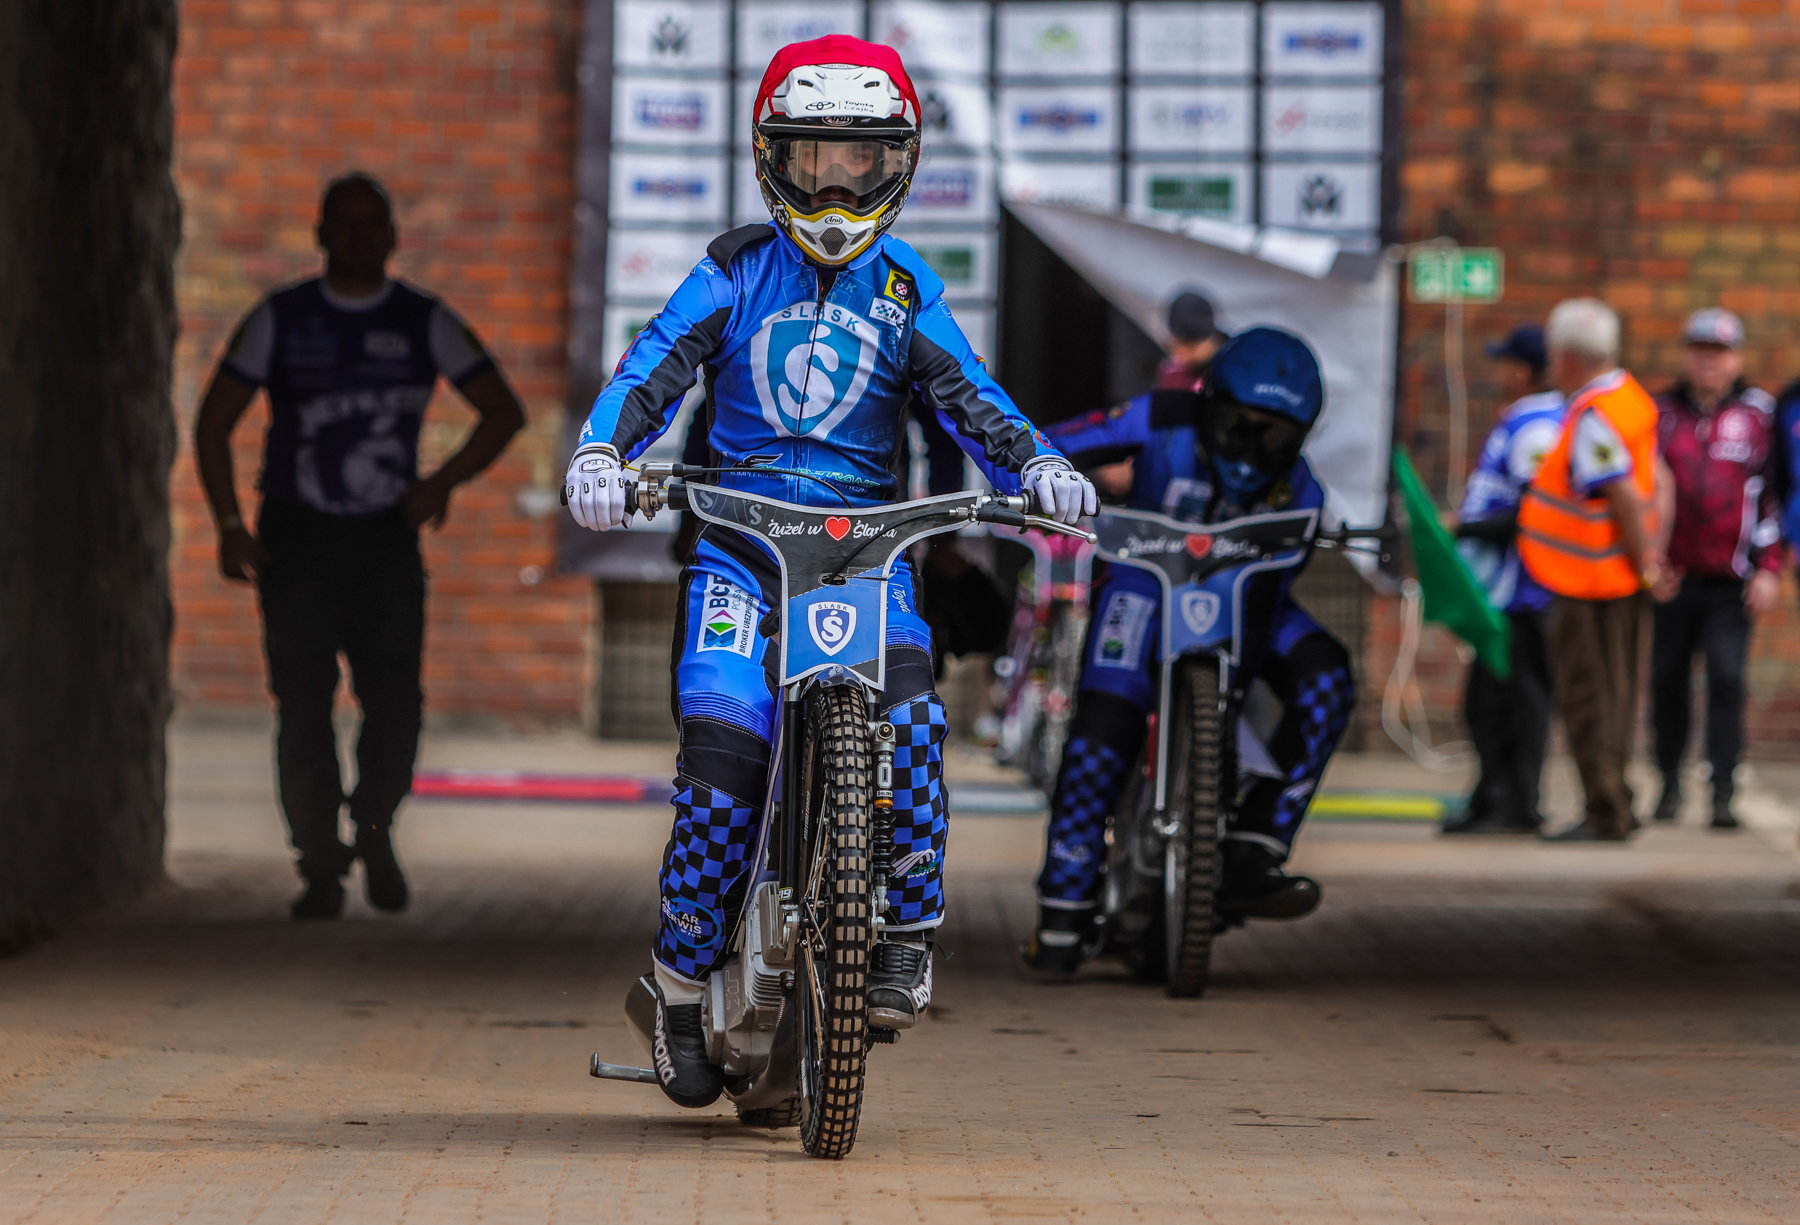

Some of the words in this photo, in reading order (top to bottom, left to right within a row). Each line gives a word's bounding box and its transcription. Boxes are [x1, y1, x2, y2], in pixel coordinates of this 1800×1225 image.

[768, 518, 805, 538] Żużel
[807, 524, 823, 535] w
[739, 629, 749, 654] BROKER
[662, 903, 702, 935] SERWIS
